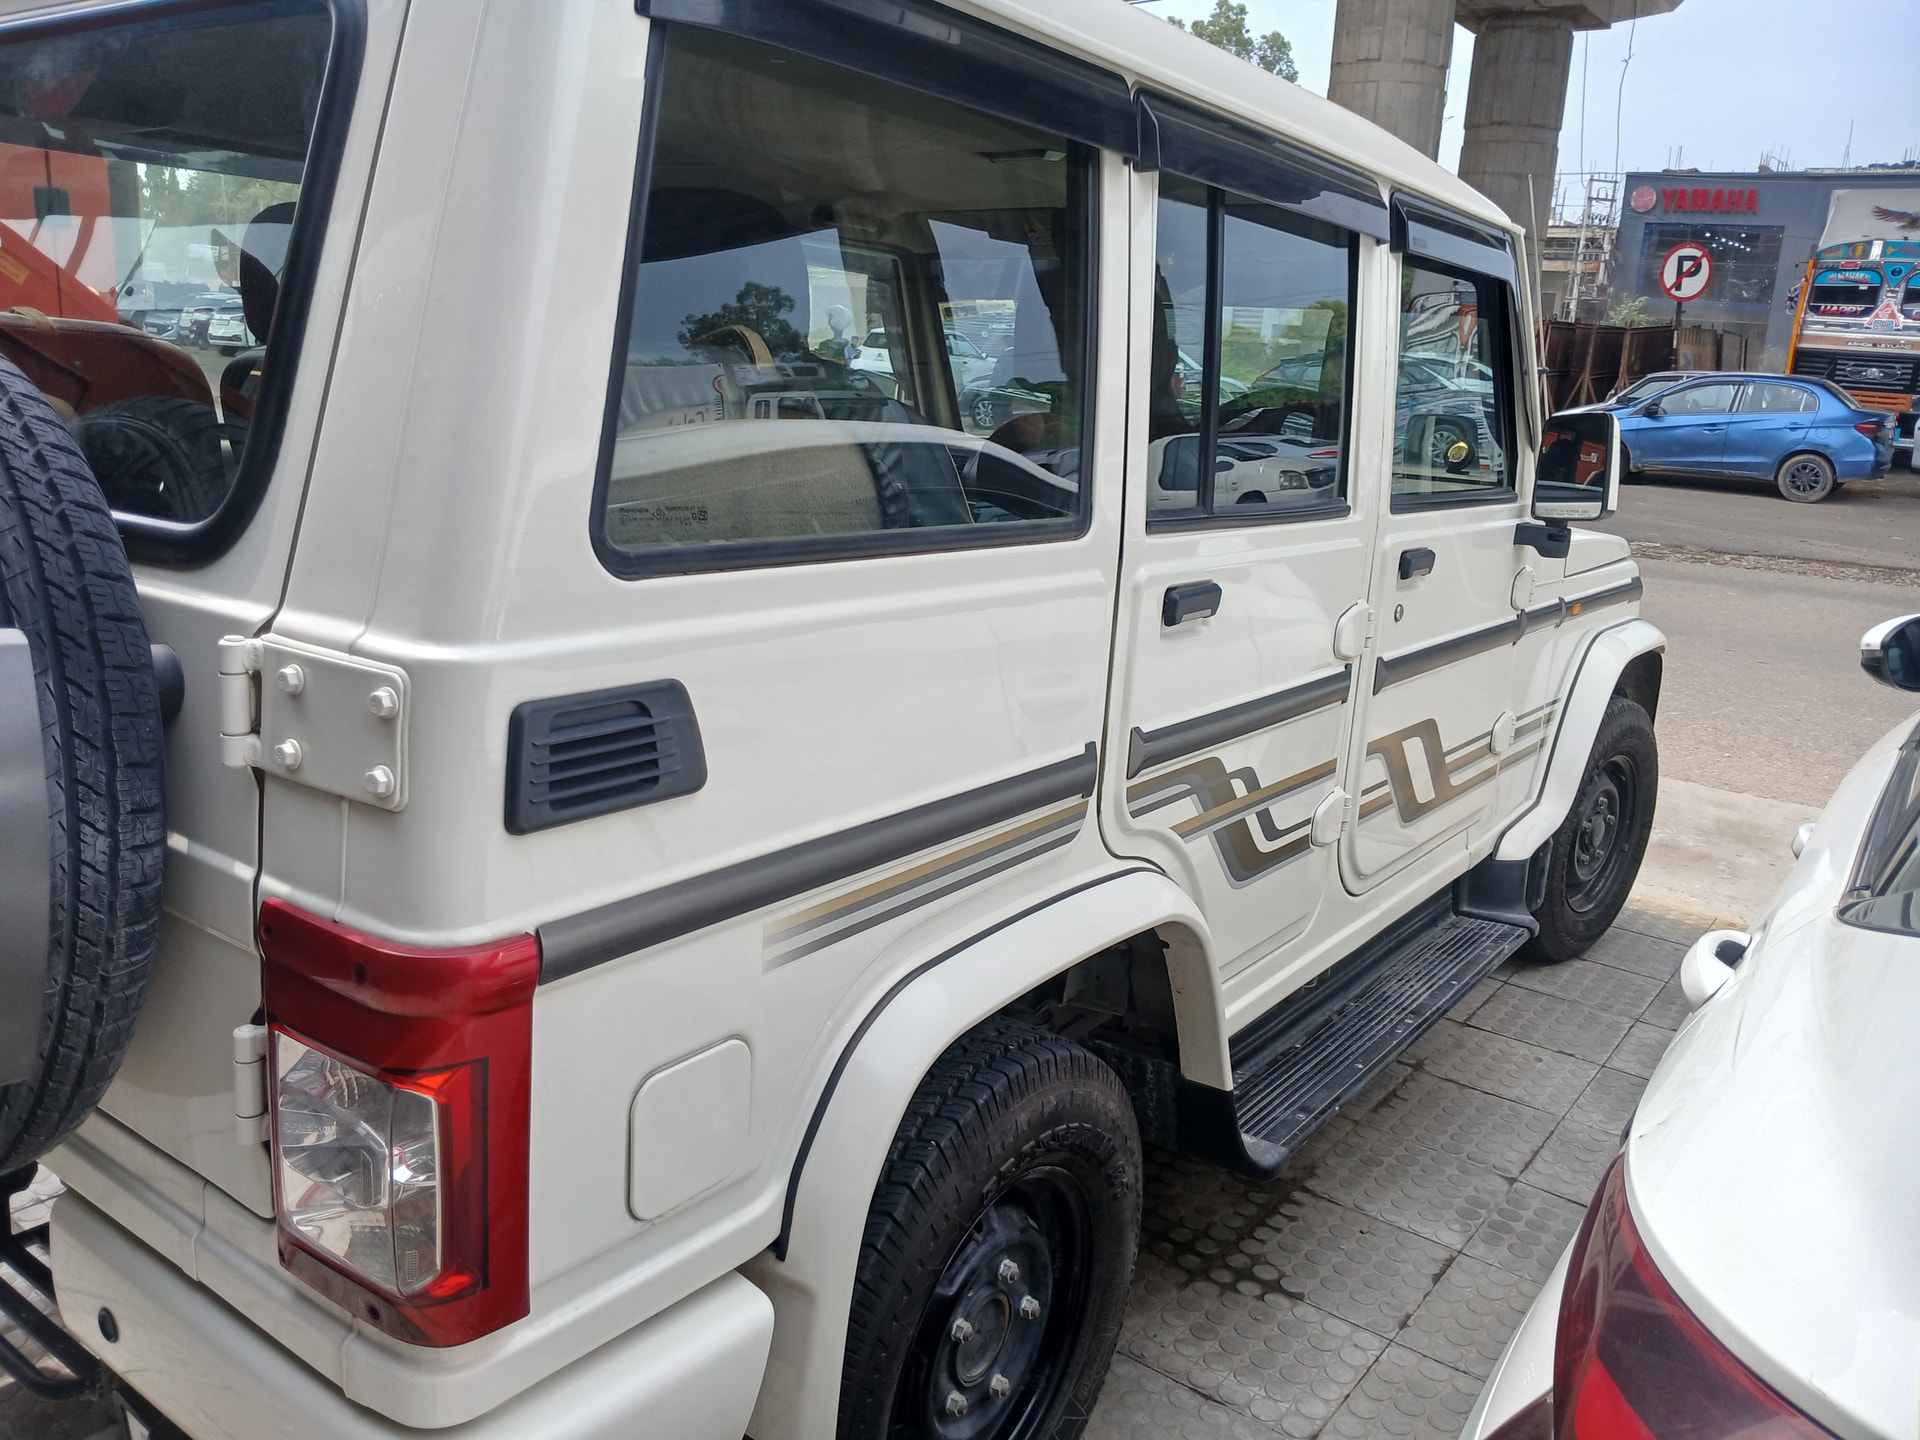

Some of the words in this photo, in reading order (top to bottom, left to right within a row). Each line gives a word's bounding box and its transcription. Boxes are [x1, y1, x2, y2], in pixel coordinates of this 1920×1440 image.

[1662, 187, 1758, 212] YAMAHA
[1675, 255, 1702, 291] P
[1818, 305, 1865, 315] HAPPY
